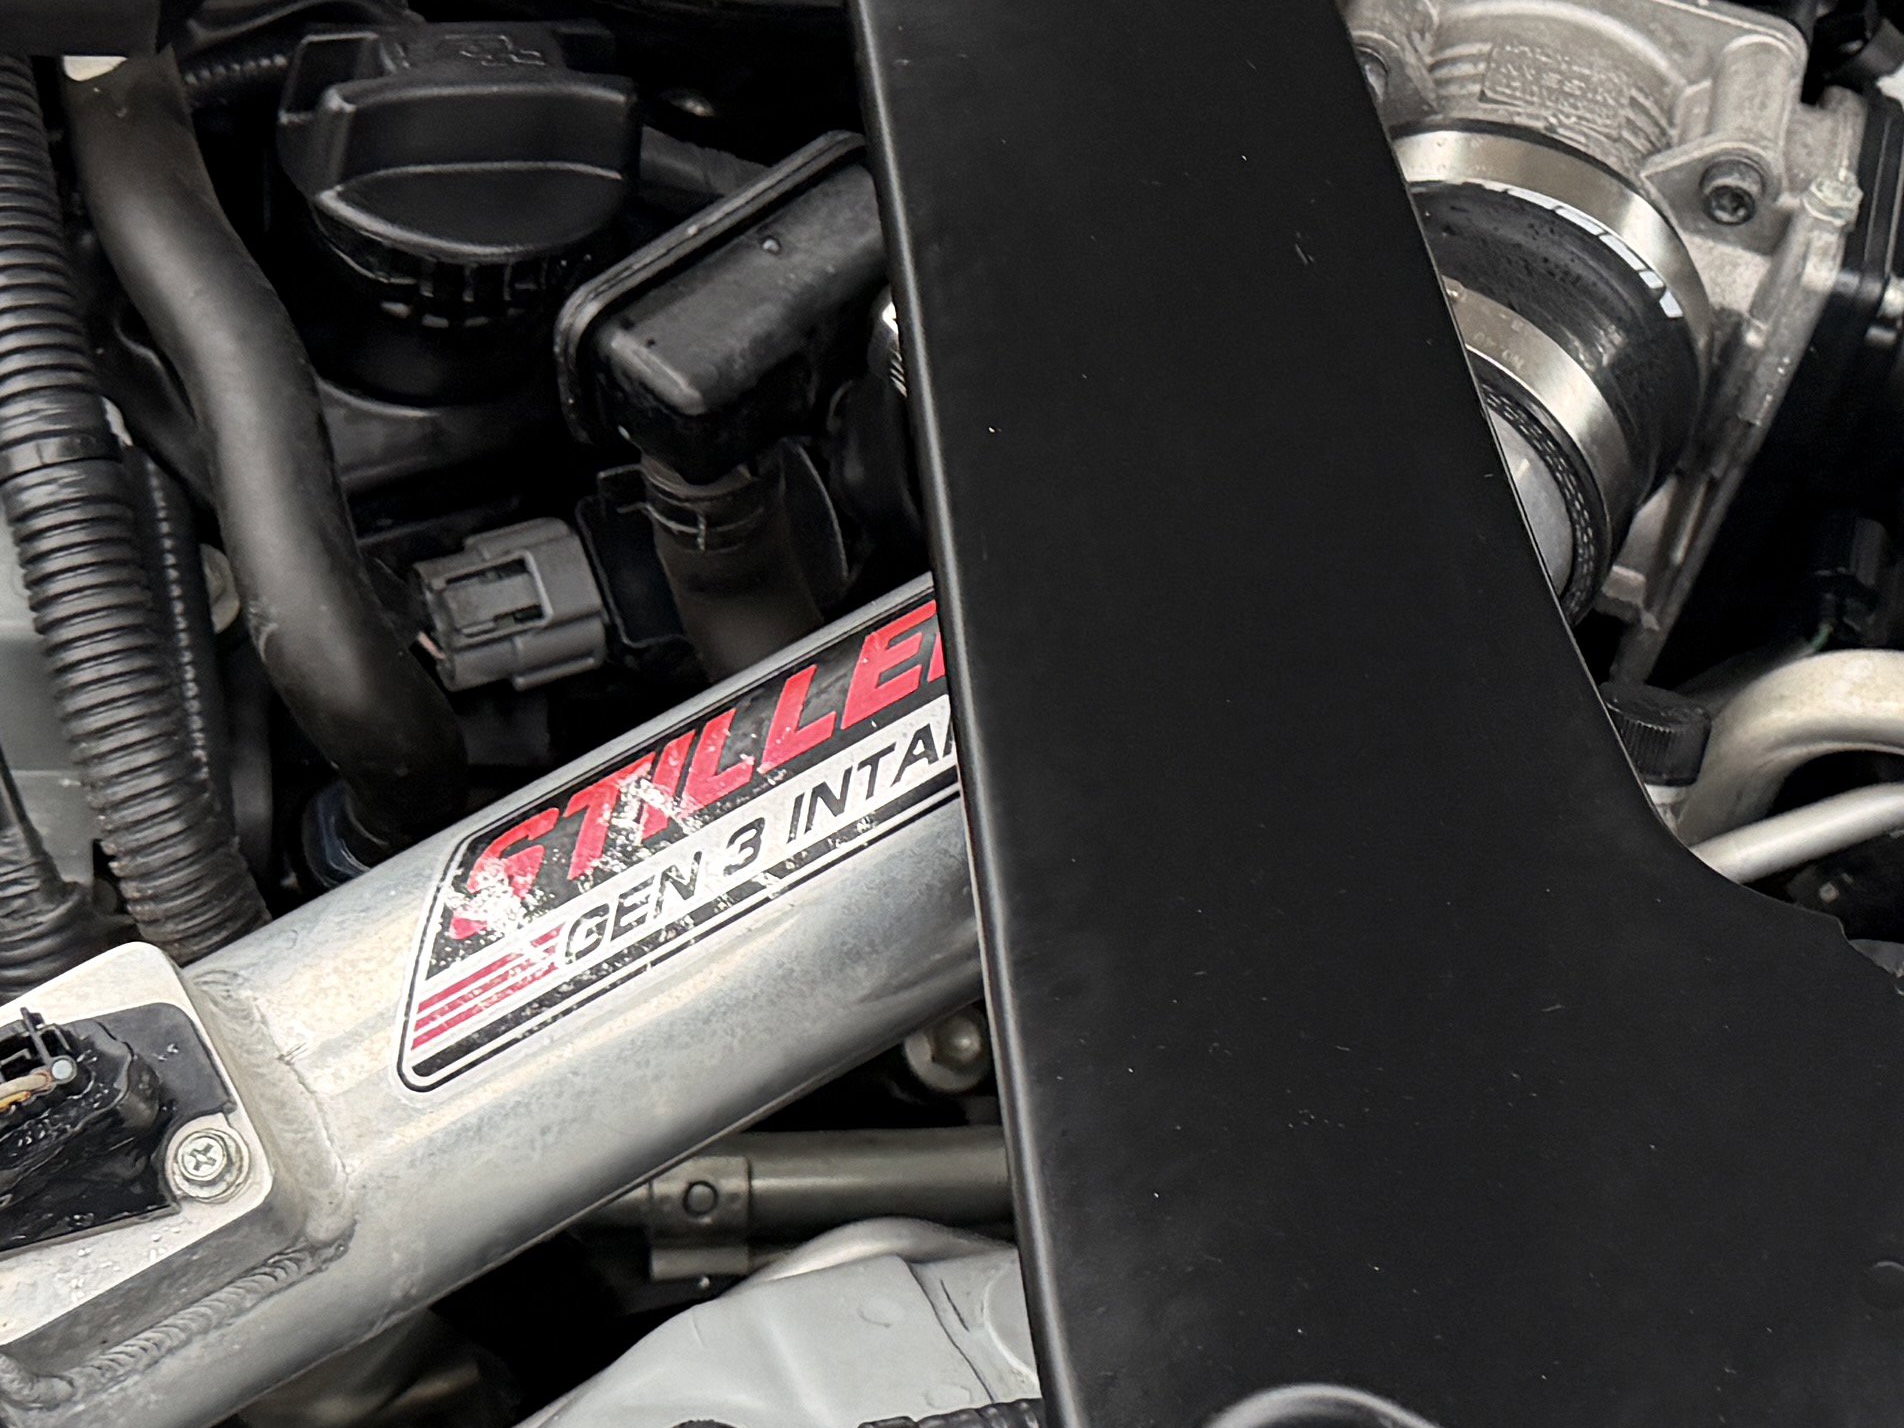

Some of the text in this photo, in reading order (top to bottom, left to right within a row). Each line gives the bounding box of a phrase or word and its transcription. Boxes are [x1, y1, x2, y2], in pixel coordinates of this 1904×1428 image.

[563, 722, 956, 966] GEN 3 INTA
